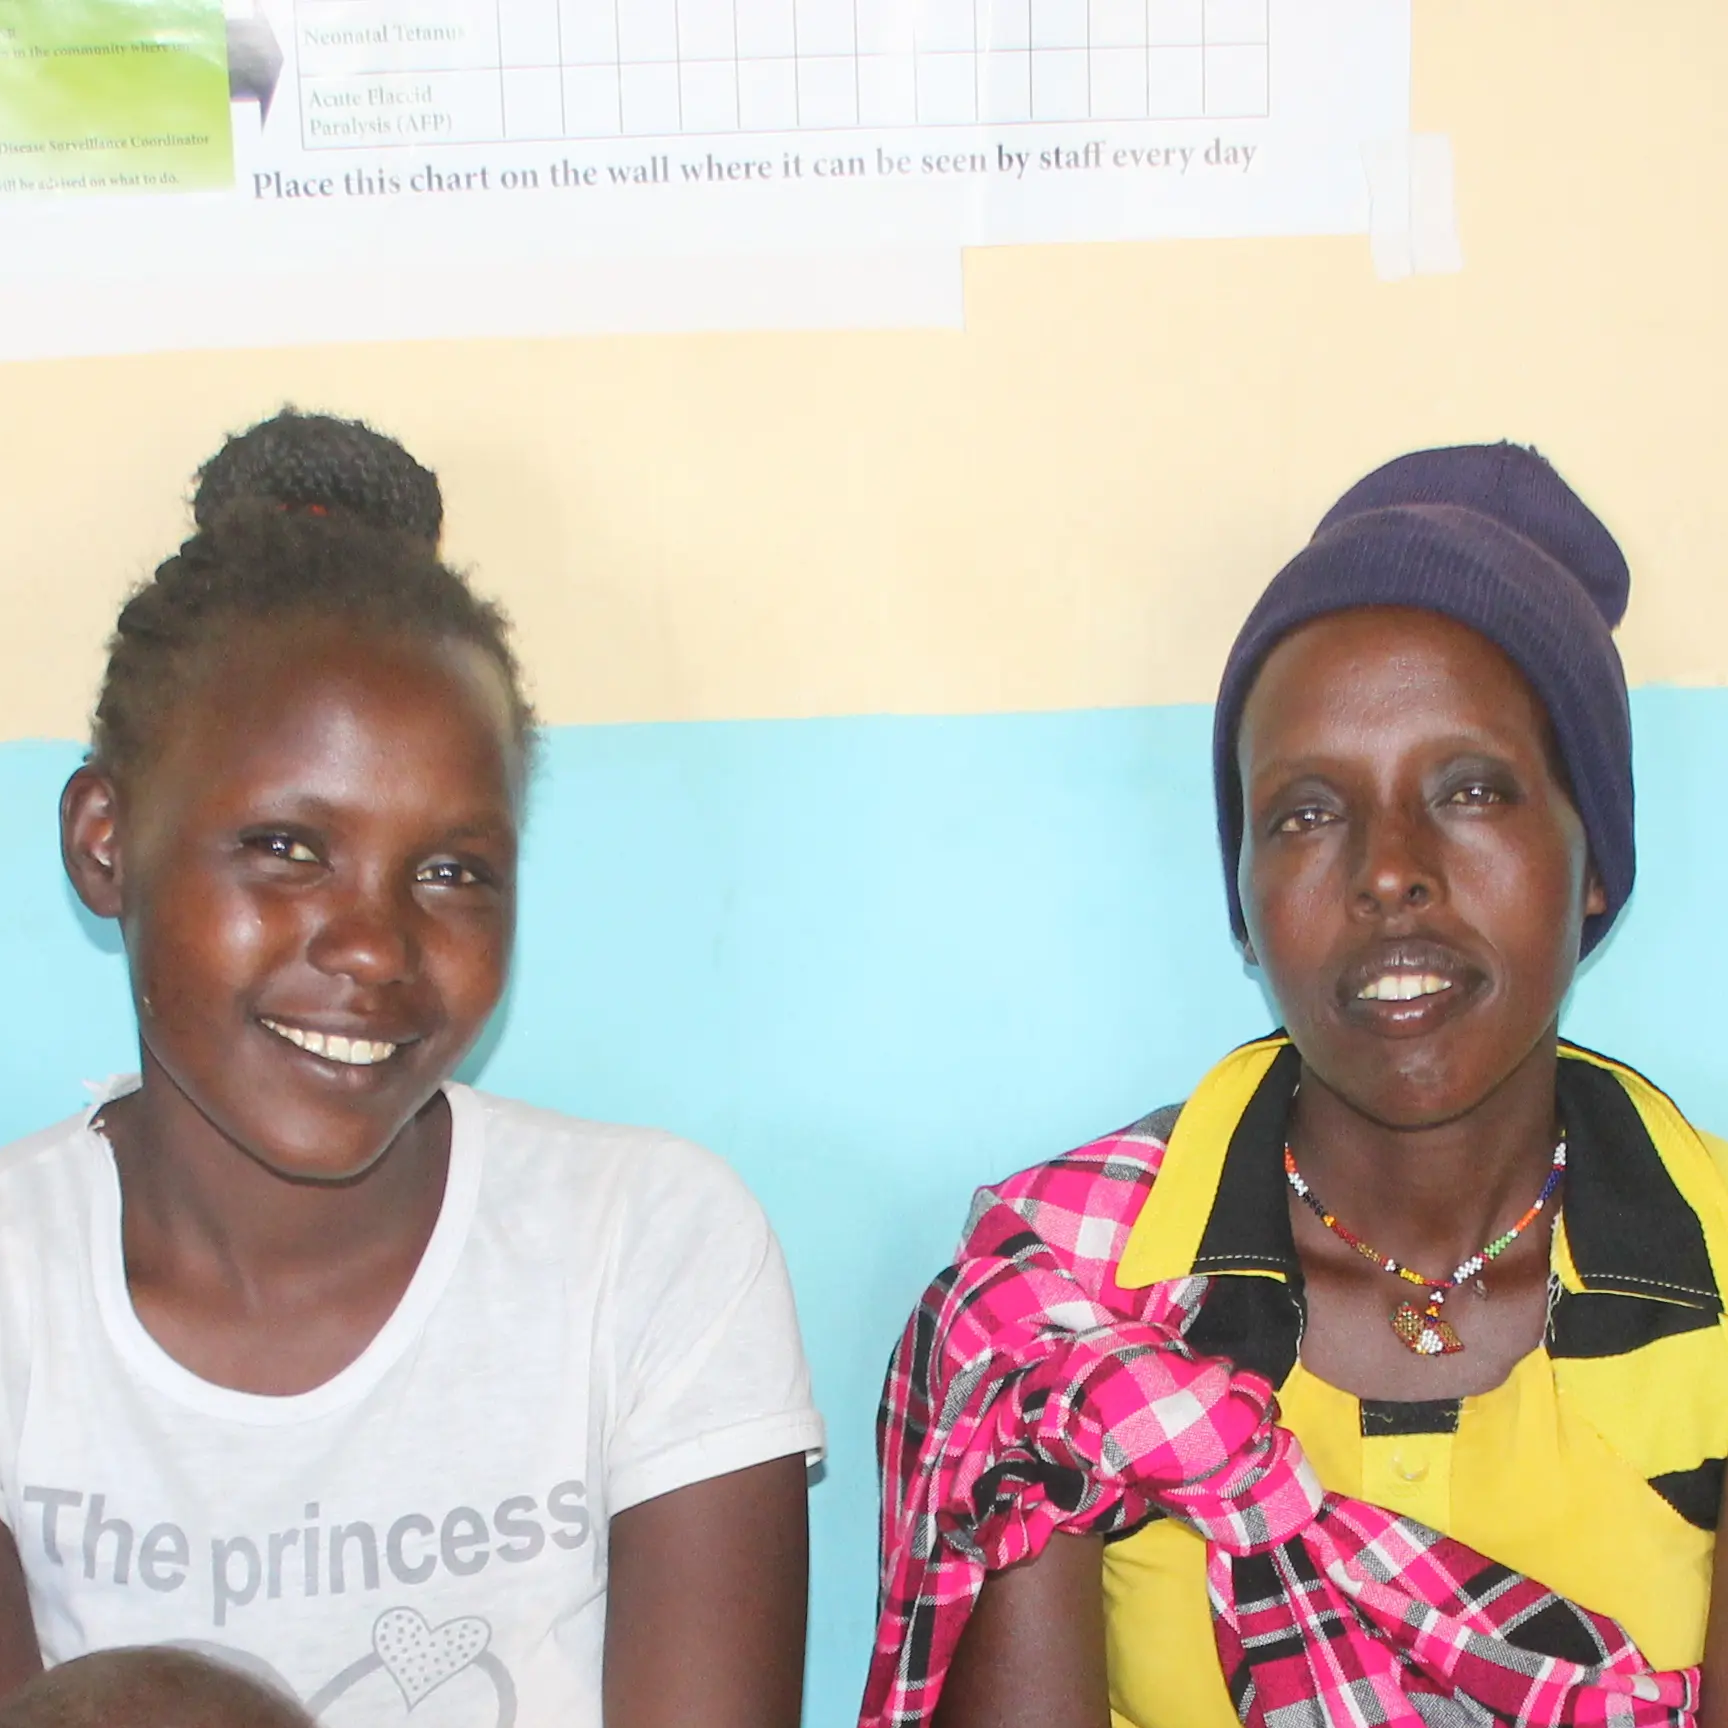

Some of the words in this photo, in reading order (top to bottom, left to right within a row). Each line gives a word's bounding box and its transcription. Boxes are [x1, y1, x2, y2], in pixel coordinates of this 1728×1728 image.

[304, 24, 389, 47] Neonatal
[309, 87, 362, 109] Acute
[309, 115, 391, 141] Paralysis
[397, 112, 454, 136] (AFP)
[252, 171, 335, 199] Place
[343, 167, 401, 196] this
[409, 164, 490, 193] chart
[501, 169, 539, 191] on
[549, 160, 598, 187] the
[608, 156, 670, 184] wall
[680, 153, 773, 183] where
[782, 152, 804, 178] it
[812, 154, 866, 179] can
[876, 146, 912, 175] be
[920, 149, 988, 174] seen
[996, 143, 1032, 180] by
[1039, 139, 1107, 170] staff
[1112, 145, 1195, 175] every
[1203, 137, 1259, 171] day
[23, 1484, 190, 1592] The
[211, 1479, 592, 1627] princess
